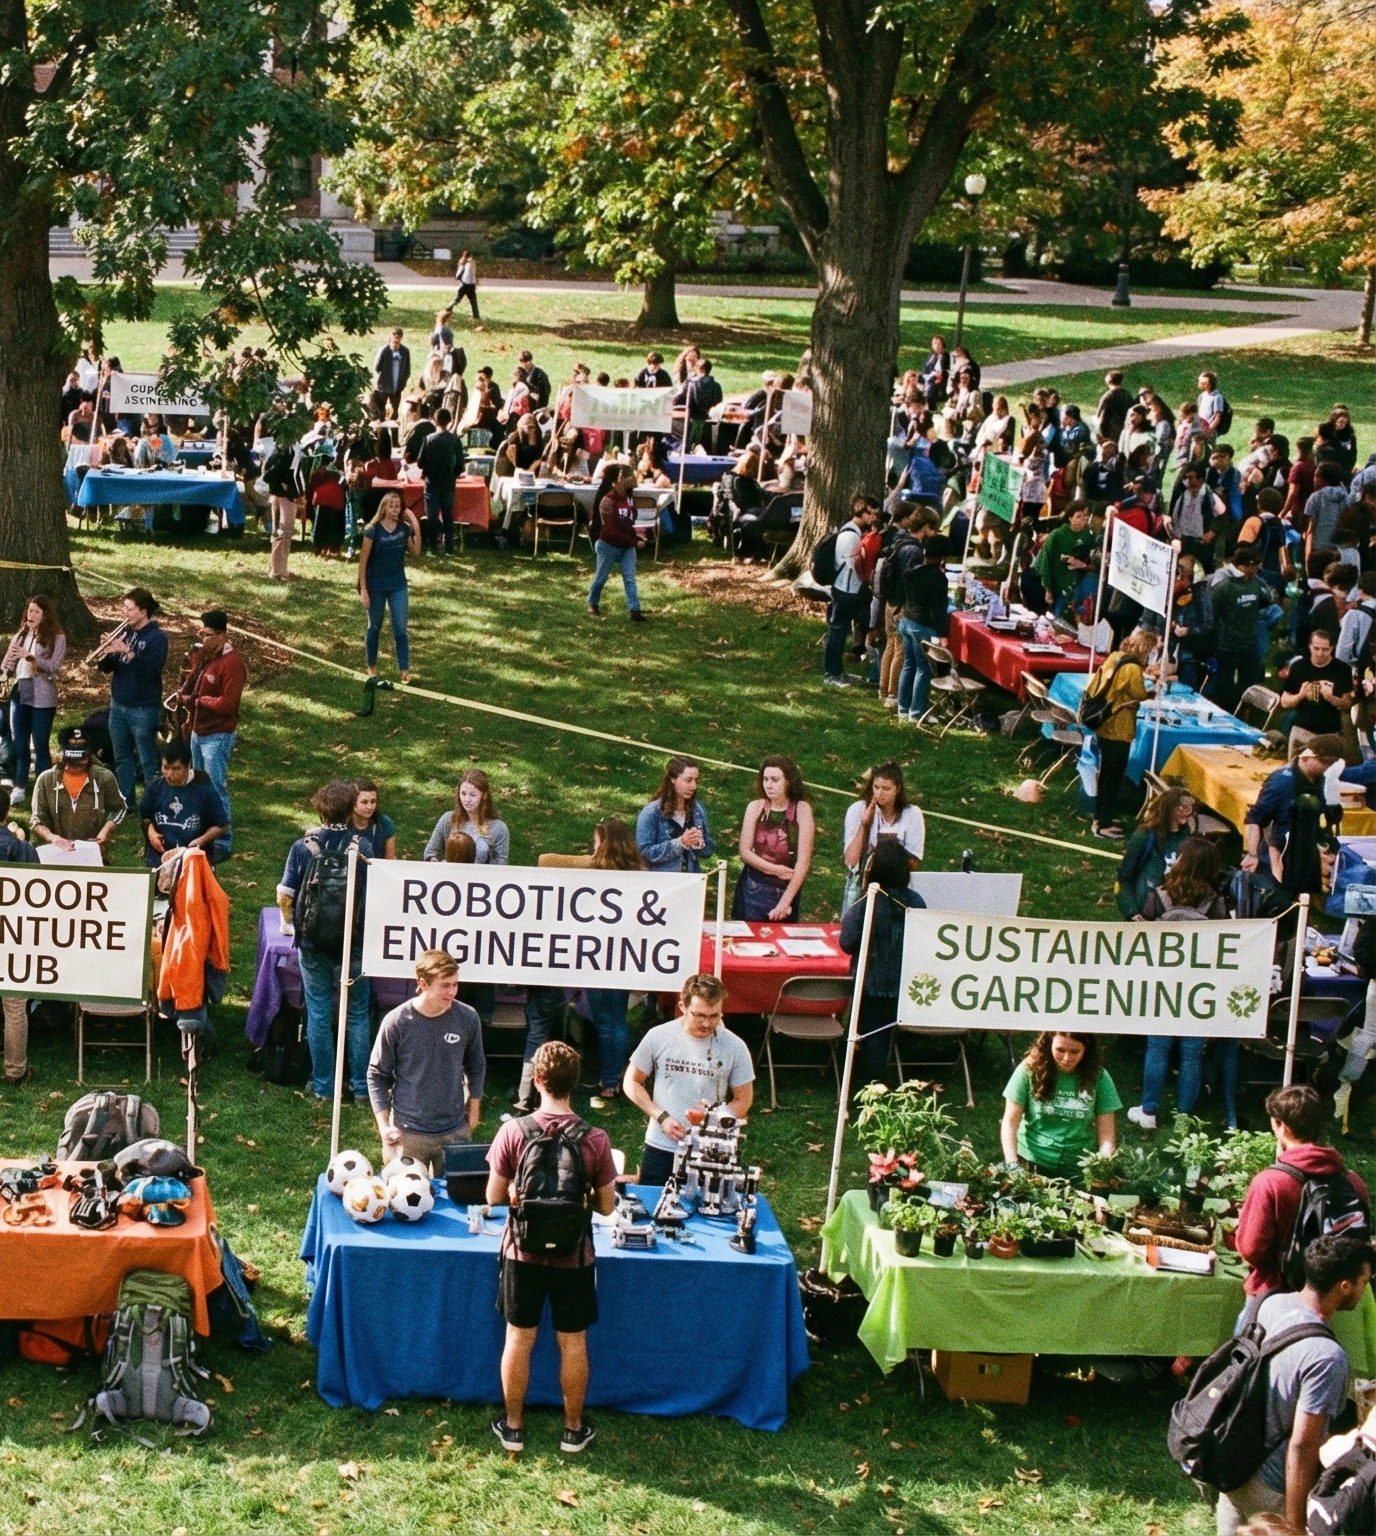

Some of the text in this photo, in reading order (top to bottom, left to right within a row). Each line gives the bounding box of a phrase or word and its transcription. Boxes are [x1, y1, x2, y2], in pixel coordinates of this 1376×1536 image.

[402, 879, 667, 927] ROBOTICS &
[382, 925, 680, 975] ENGINEERING
[935, 923, 1241, 970] SUSTAINABLE
[950, 973, 1217, 1020] GARDENING
